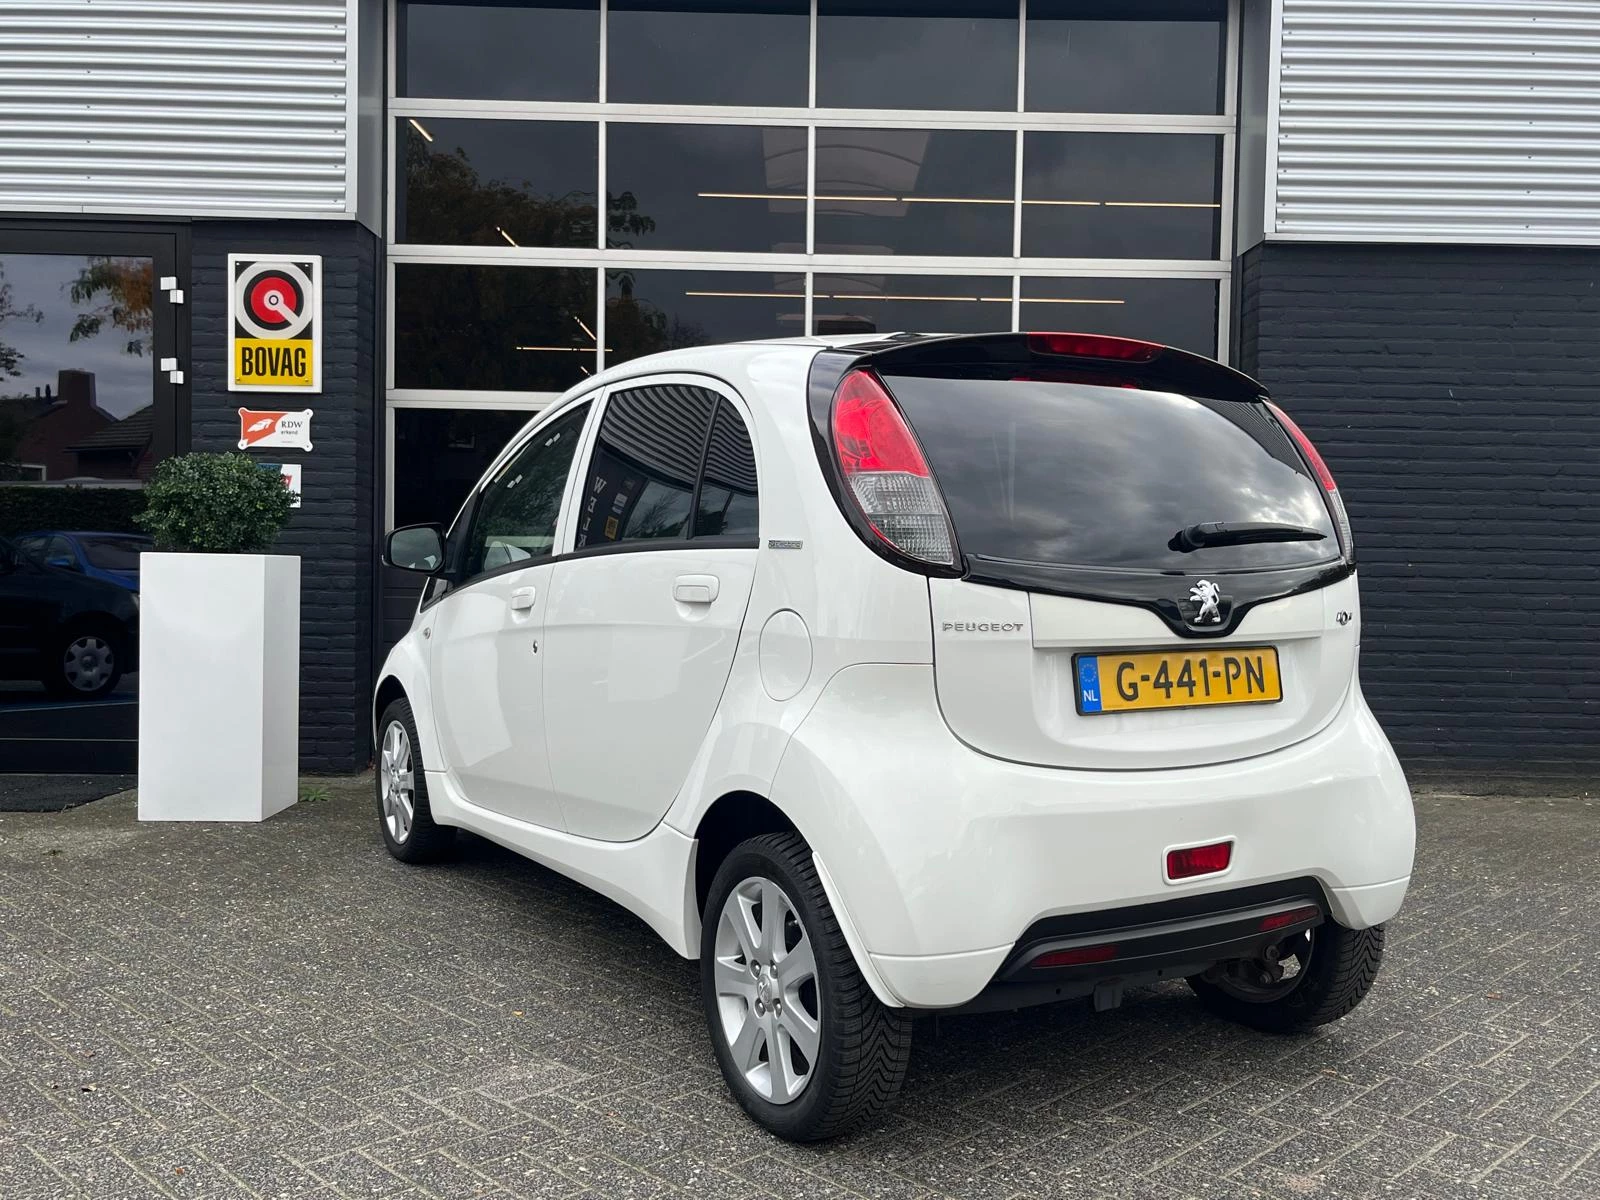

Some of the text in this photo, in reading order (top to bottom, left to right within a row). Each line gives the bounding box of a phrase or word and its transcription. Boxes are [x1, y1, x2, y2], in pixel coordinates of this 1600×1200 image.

[242, 346, 306, 377] BOVAG
[281, 420, 303, 428] RDW
[942, 622, 1023, 632] PEUGEOT
[1083, 656, 1265, 702] NL G-441-PN
